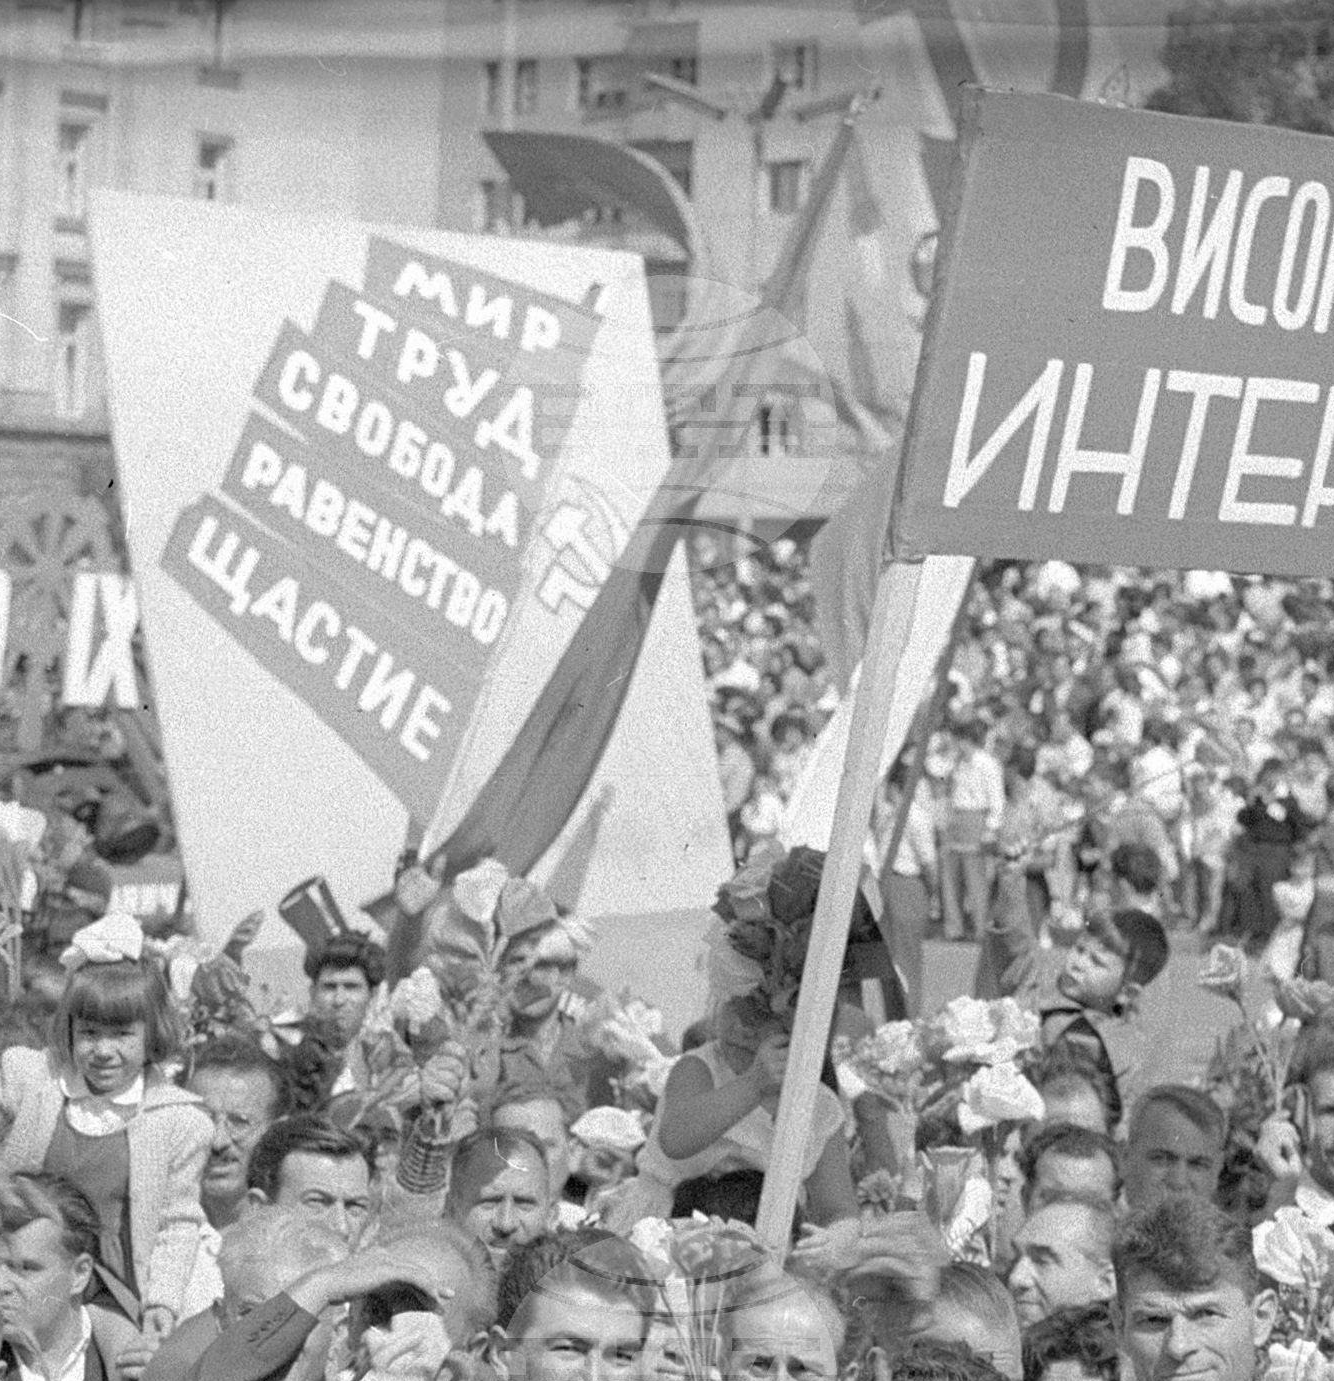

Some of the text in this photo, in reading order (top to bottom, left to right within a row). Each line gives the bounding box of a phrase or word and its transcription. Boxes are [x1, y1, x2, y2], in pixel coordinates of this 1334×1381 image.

[353, 301, 543, 480] ТРУД
[393, 261, 562, 352] МИР
[242, 441, 509, 645] РАВЕНСТВО
[278, 350, 522, 548] СВОБОДА
[187, 514, 454, 761] ЩАСТИЕ
